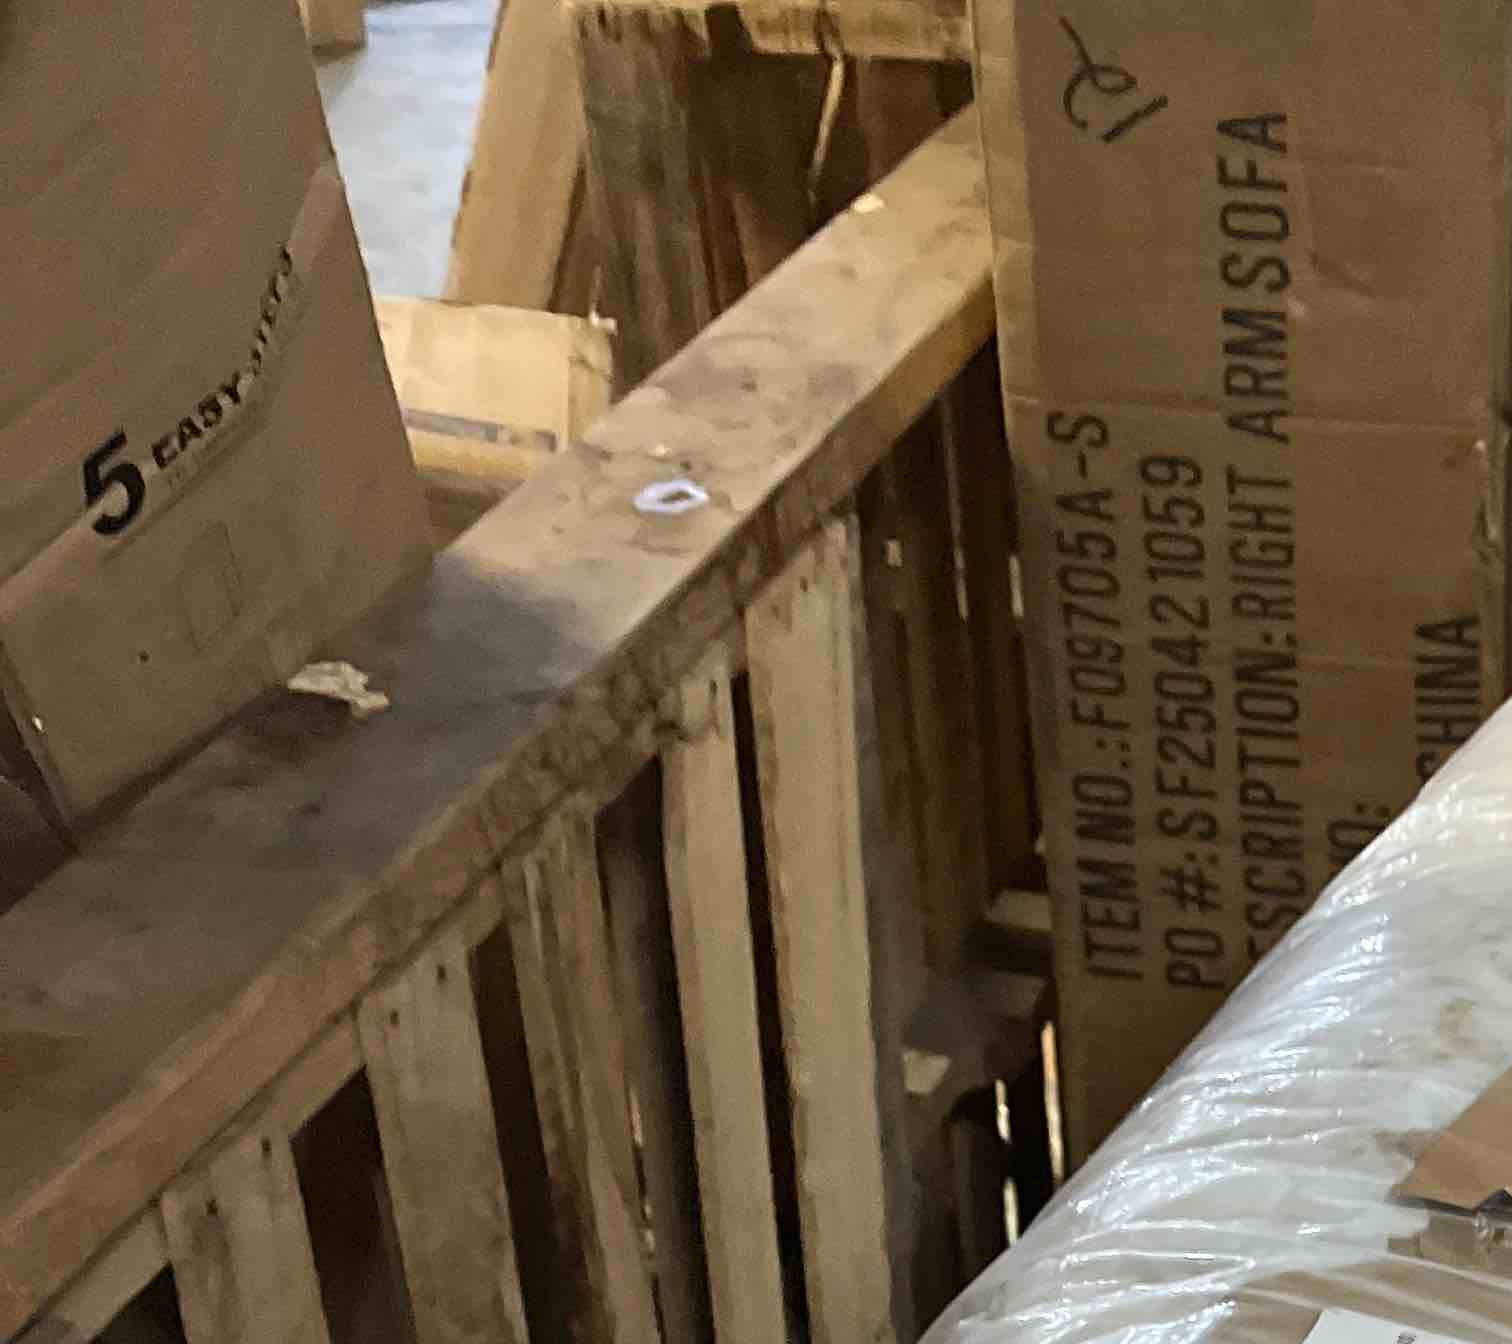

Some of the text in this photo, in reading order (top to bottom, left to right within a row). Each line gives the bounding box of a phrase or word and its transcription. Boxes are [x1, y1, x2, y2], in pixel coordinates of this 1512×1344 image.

[83, 430, 146, 535] 5
[1215, 112, 1309, 960] SCRIPTION:RIGHT ARM SOFA
[1075, 858, 1143, 981] ITEM
[1164, 926, 1227, 991] PO
